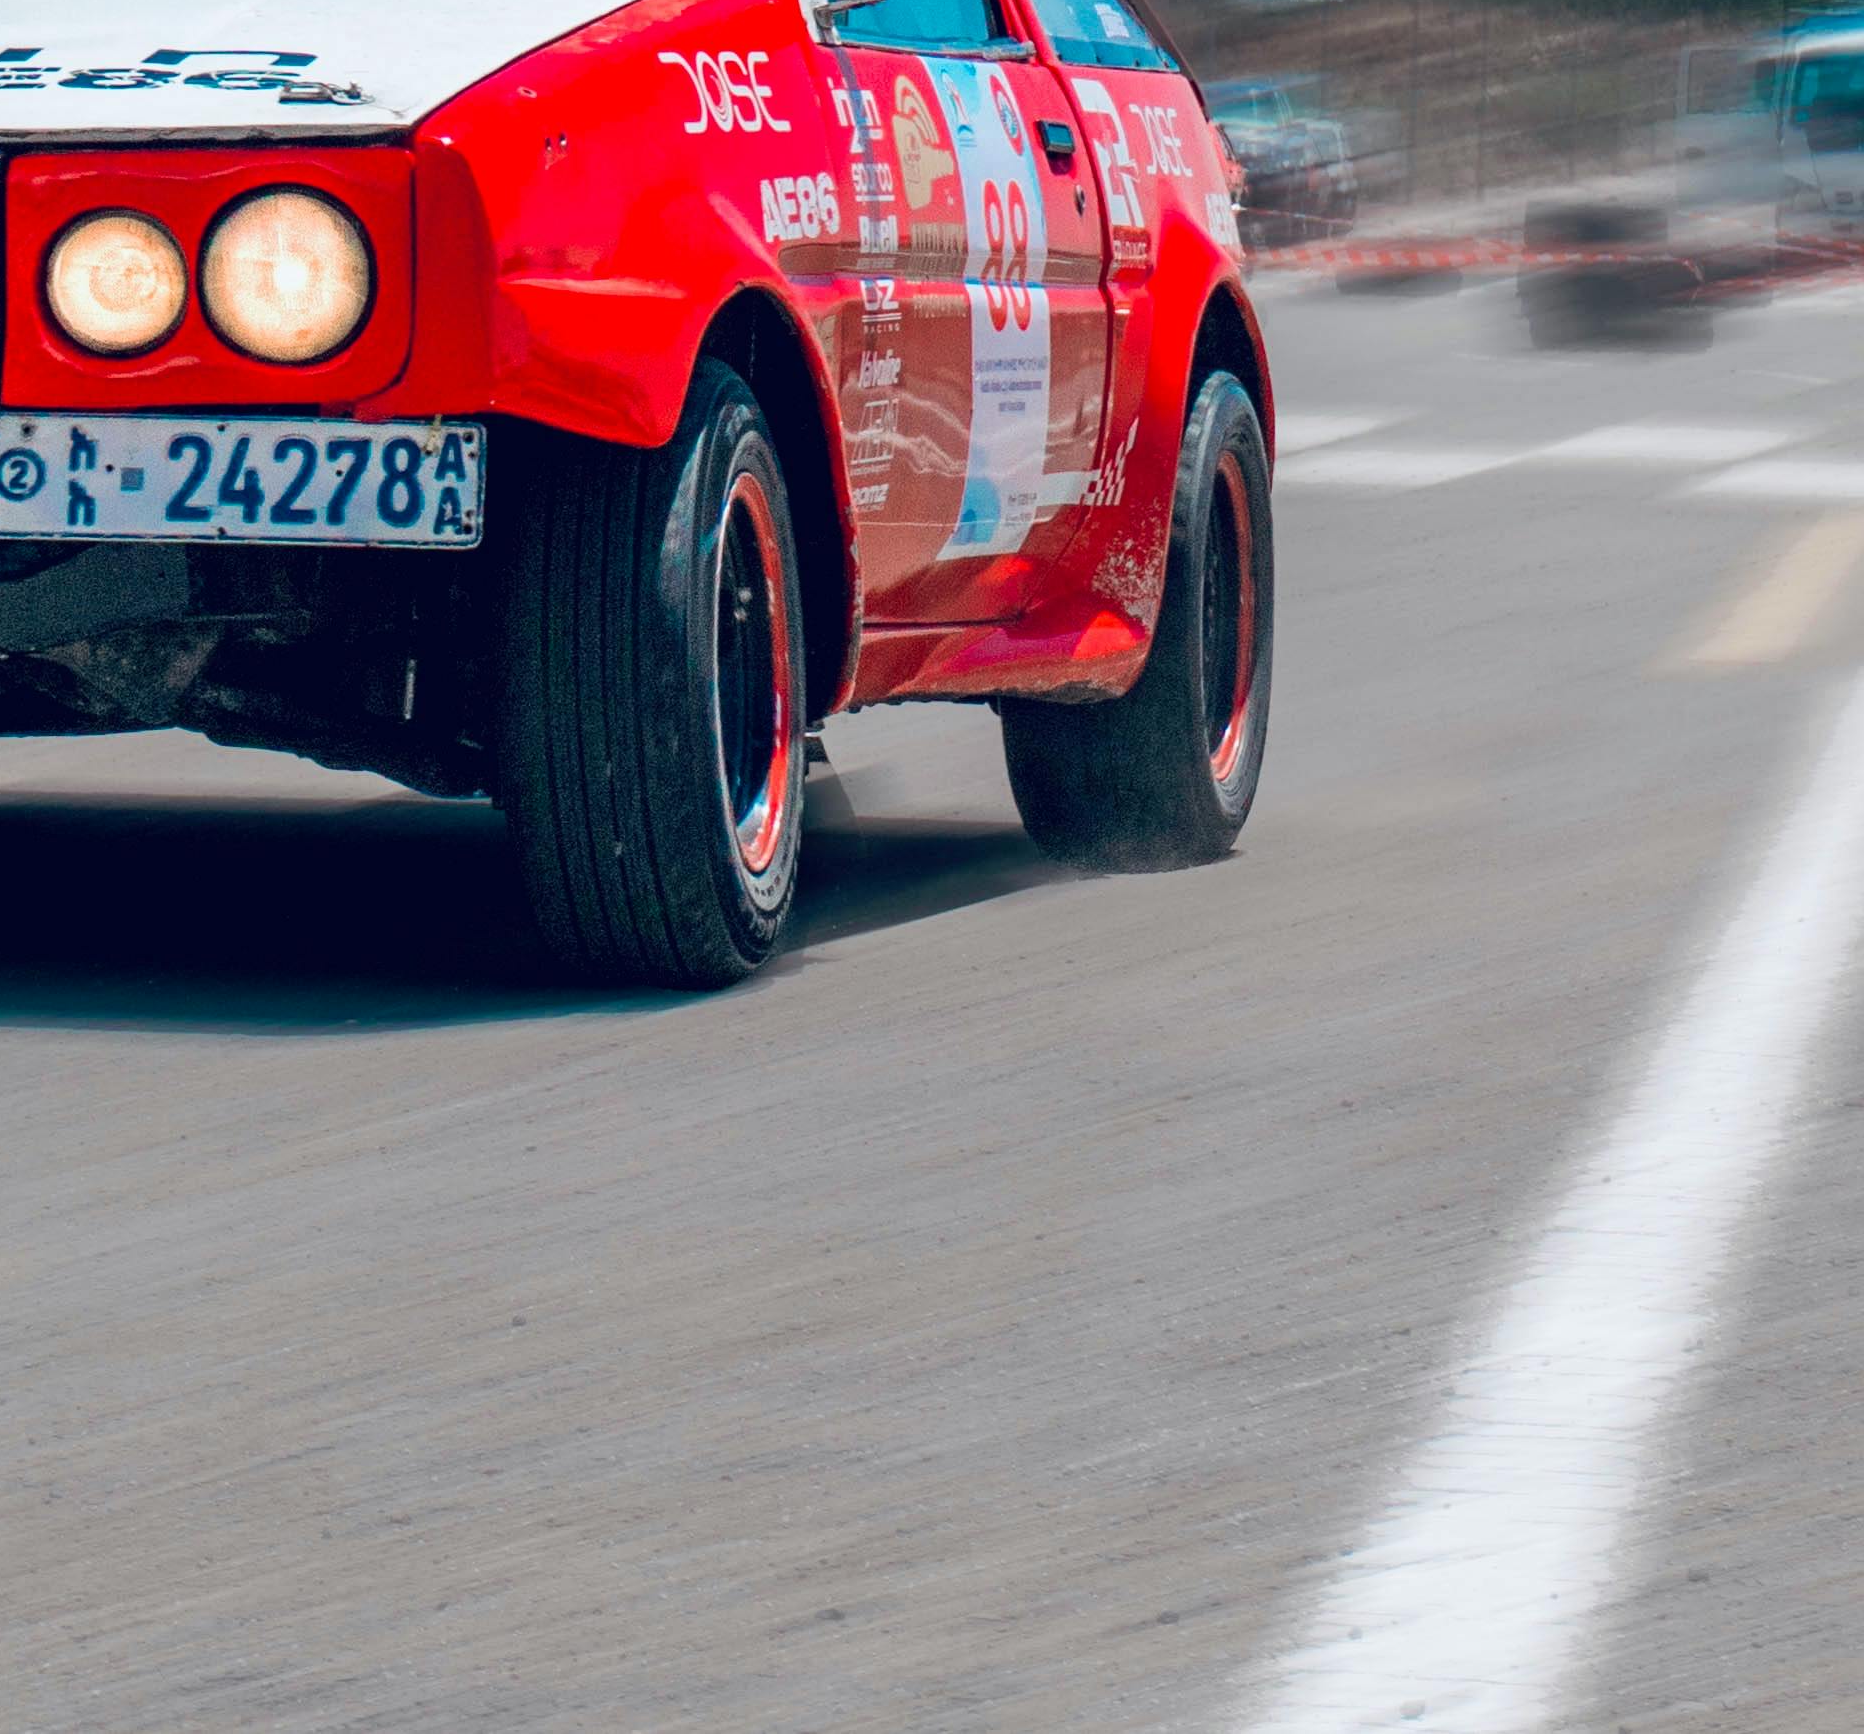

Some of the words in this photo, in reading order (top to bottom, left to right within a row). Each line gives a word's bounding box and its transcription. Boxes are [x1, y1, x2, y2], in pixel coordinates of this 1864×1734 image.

[657, 50, 792, 134] JOSE
[1129, 103, 1193, 178] JOSE
[759, 171, 840, 243] AE86
[164, 433, 424, 529] 24278
